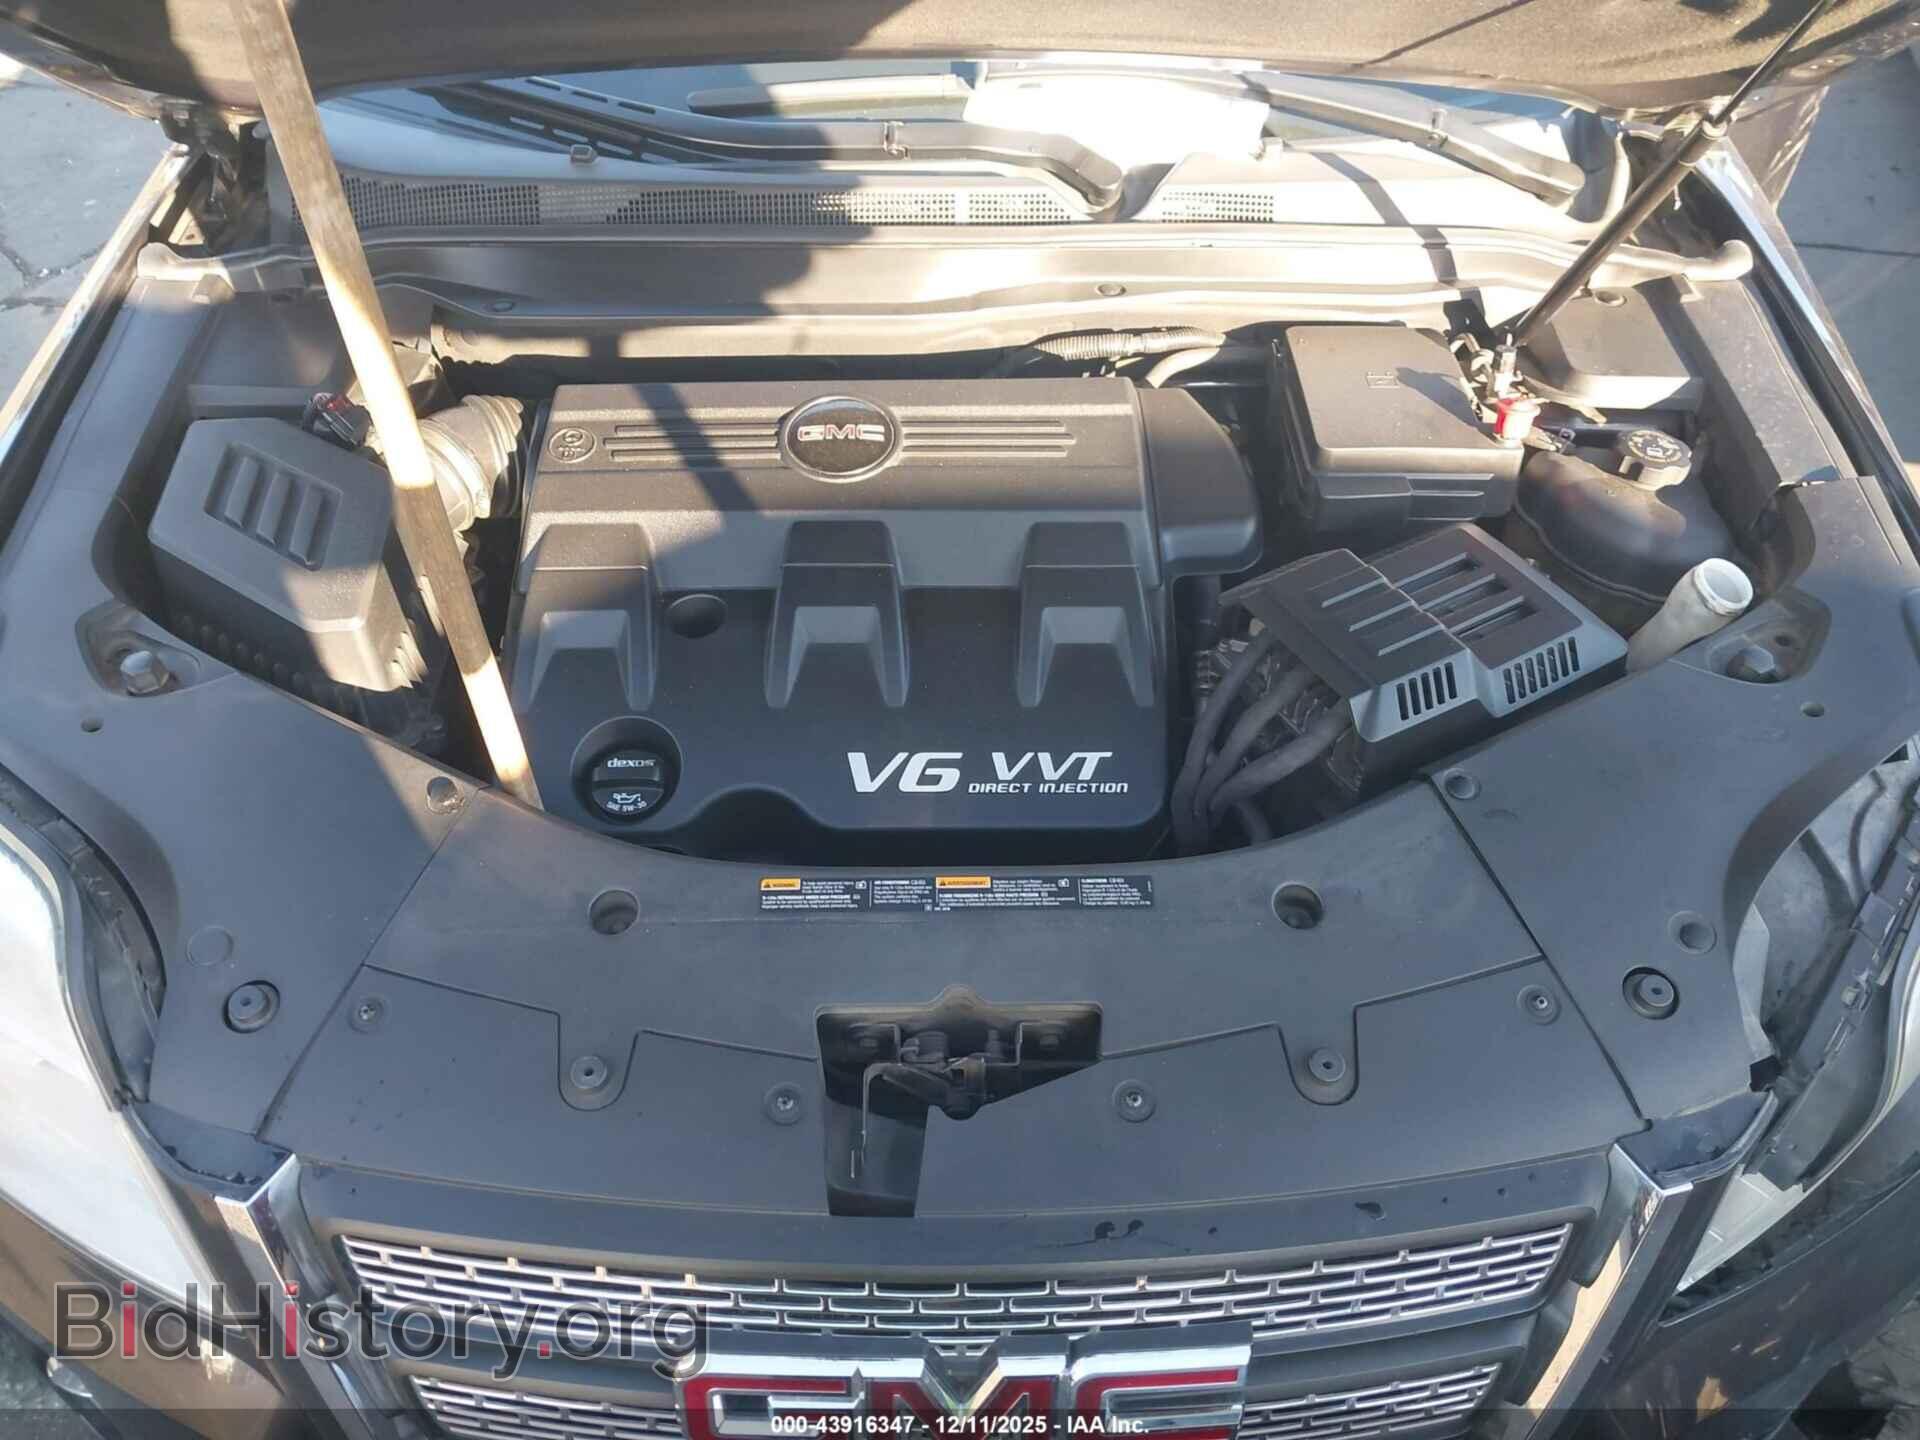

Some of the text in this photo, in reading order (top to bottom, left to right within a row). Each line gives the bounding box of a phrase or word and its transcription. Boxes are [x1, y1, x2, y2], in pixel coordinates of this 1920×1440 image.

[797, 423, 885, 442] GMC
[607, 757, 656, 768] dexos
[847, 751, 1114, 793] V6 VVT
[968, 782, 1129, 793] DIRECT INJECTION
[674, 1346, 1252, 1440] GMC
